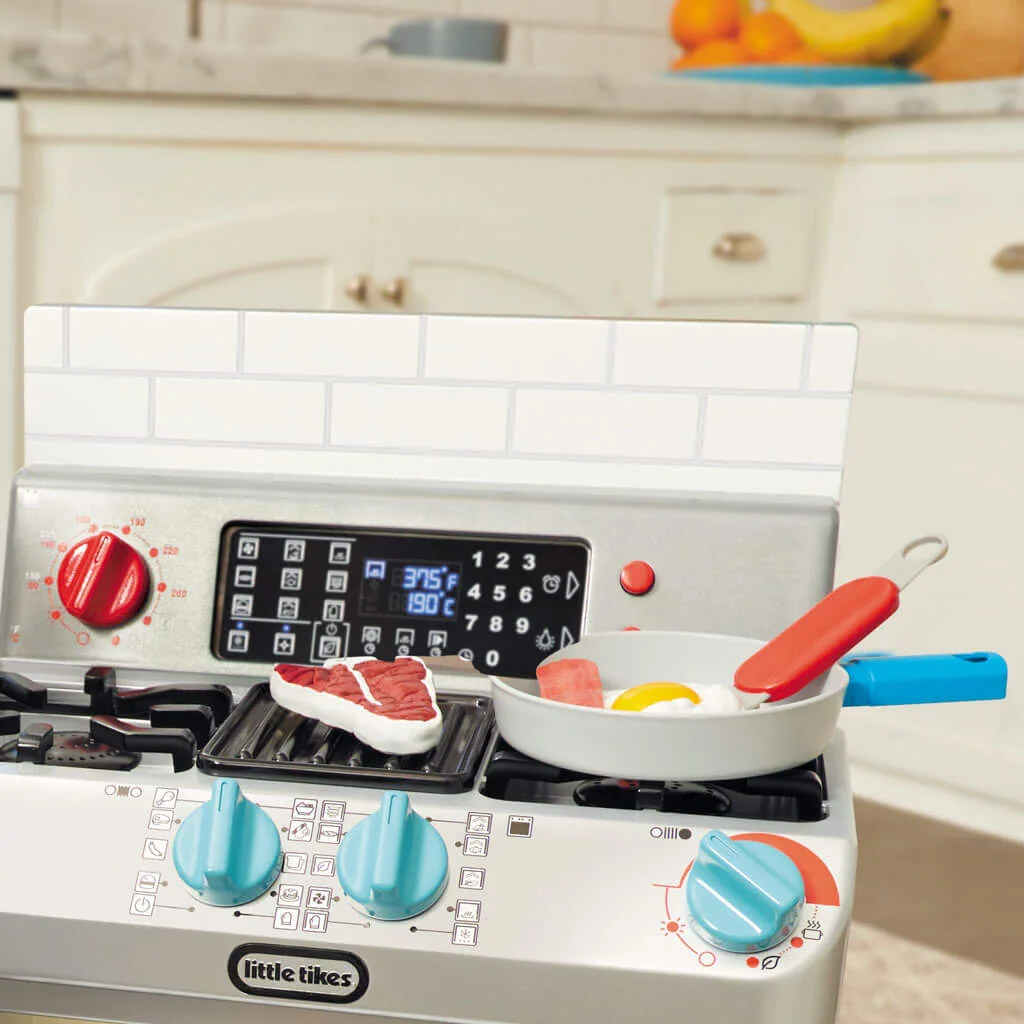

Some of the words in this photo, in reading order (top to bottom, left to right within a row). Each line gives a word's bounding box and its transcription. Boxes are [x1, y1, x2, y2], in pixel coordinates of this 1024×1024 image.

[472, 550, 483, 568] 1
[496, 552, 510, 569] 2
[522, 553, 536, 570] 3
[467, 583, 481, 600] 4
[493, 584, 507, 601] 5
[519, 586, 533, 603] 6
[465, 614, 479, 631] 7
[489, 615, 503, 632] 8
[516, 617, 529, 634] 9
[485, 649, 500, 667] 0
[244, 959, 295, 982] little
[299, 965, 352, 987] tikes
